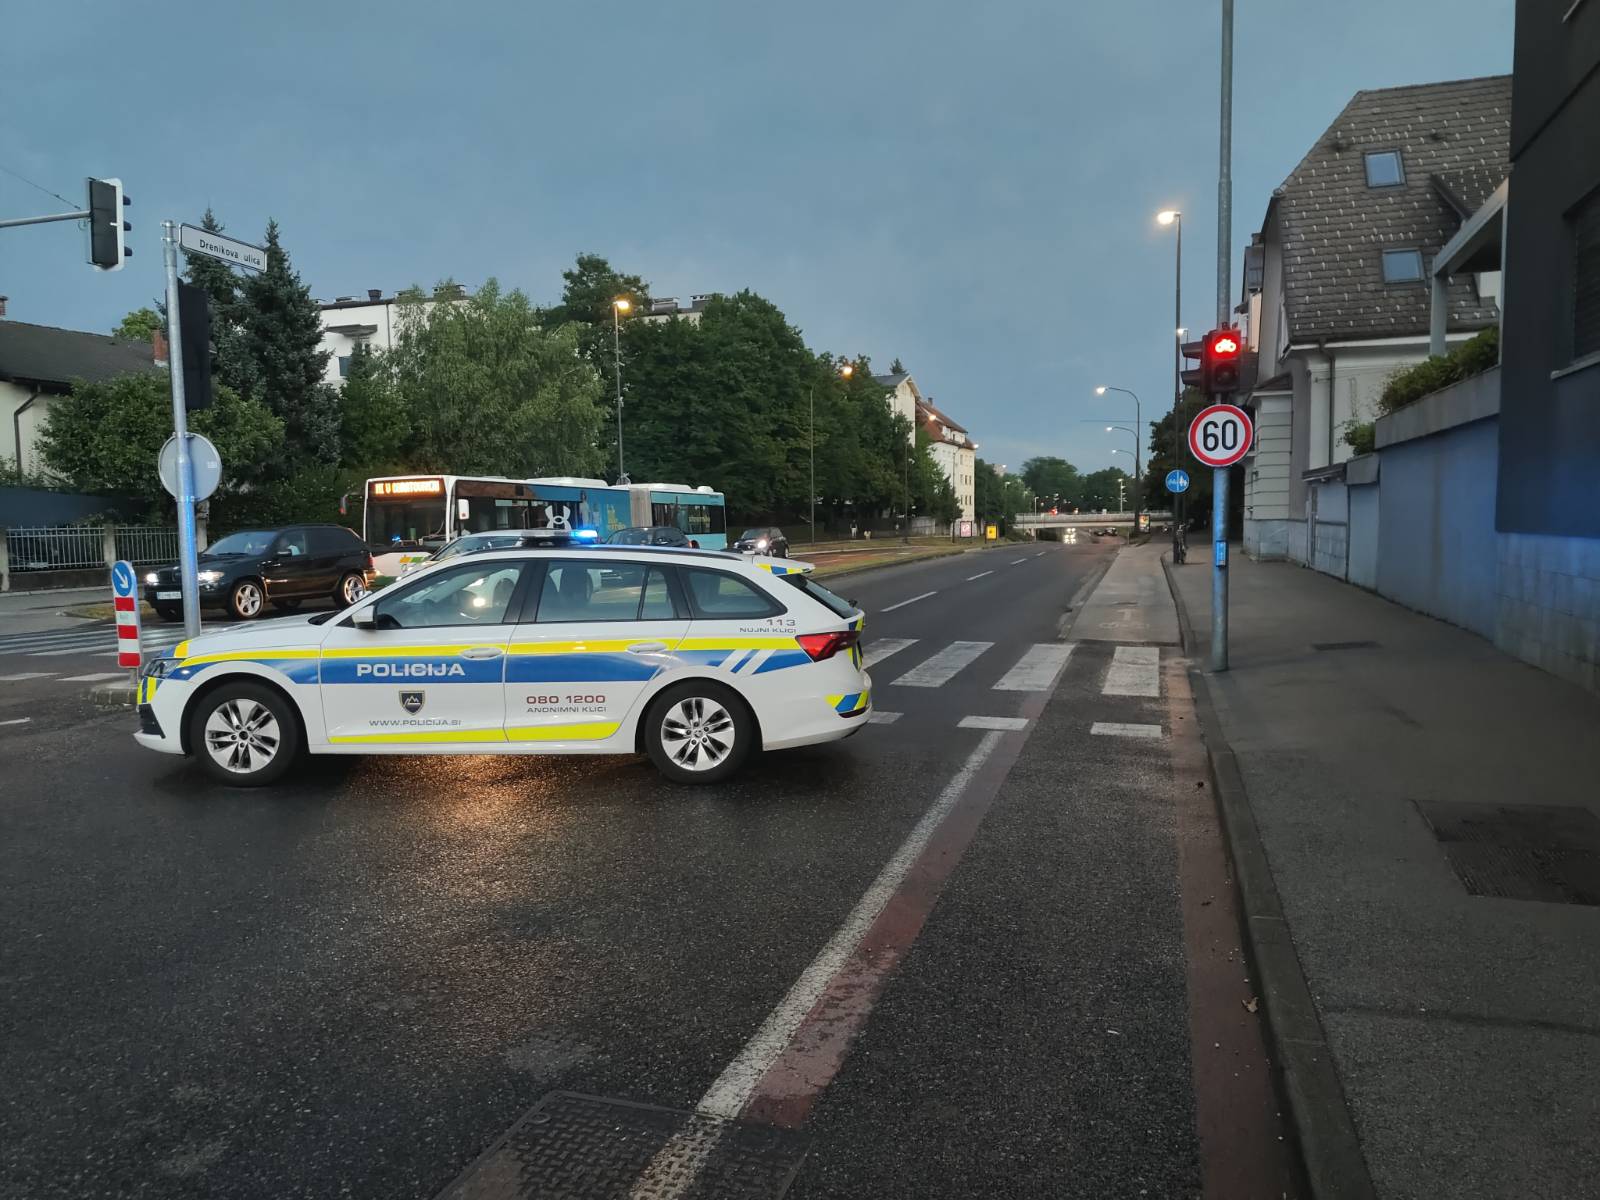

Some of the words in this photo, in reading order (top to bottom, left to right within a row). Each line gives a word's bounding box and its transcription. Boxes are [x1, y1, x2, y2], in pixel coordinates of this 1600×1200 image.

[199, 239, 239, 259] Drenikova
[243, 254, 261, 266] ulica
[1203, 419, 1238, 452] 60
[766, 619, 796, 627] 113
[357, 663, 466, 677] POLICIJA
[526, 695, 559, 704] 080
[566, 695, 606, 704] 1200
[369, 719, 462, 727] WWW.POLICIJA.SI
